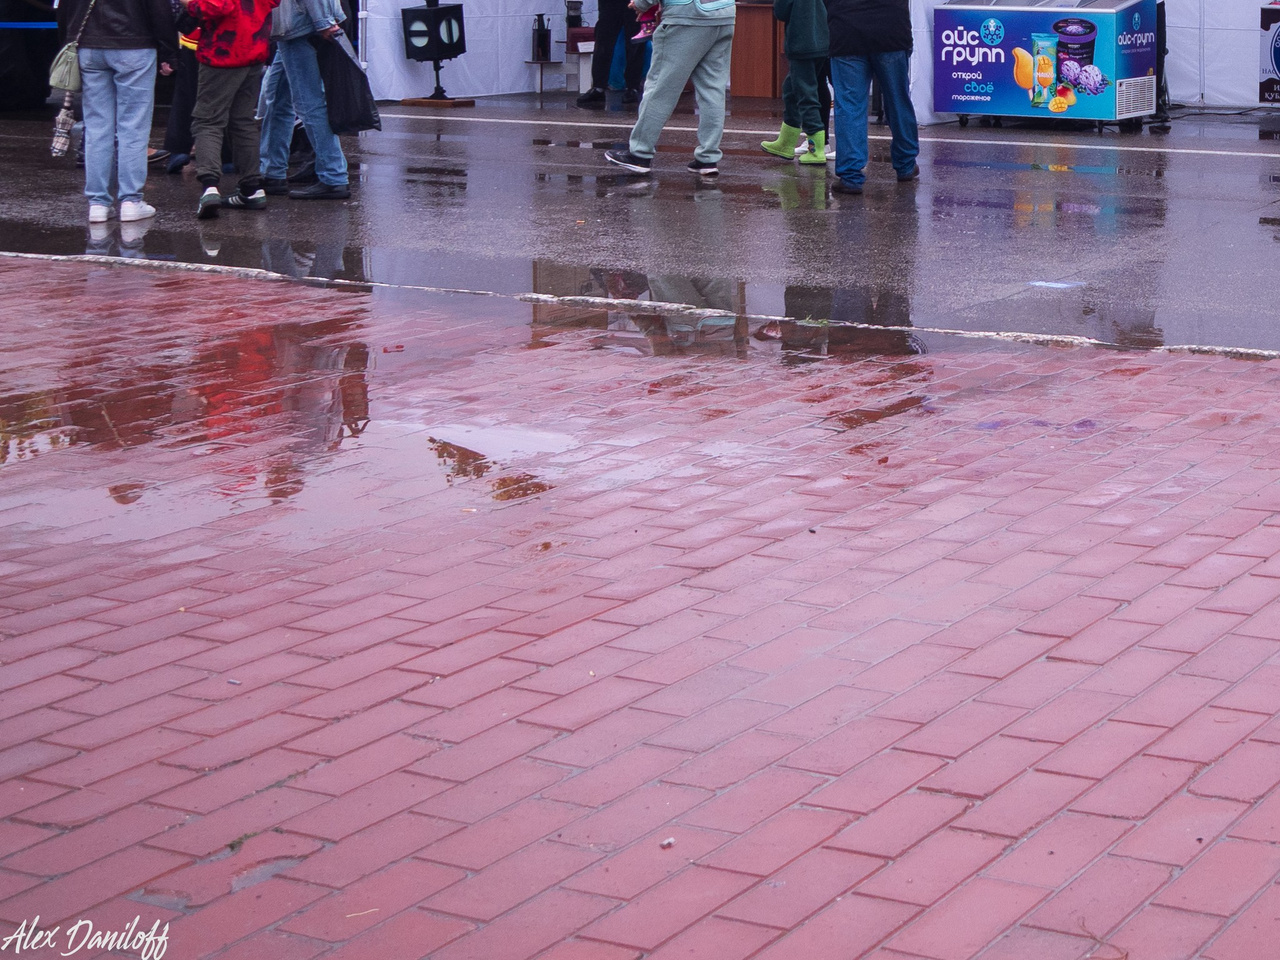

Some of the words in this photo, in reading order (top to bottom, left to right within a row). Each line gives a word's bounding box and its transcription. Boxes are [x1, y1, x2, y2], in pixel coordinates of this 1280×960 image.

[941, 26, 979, 45] айс
[1117, 31, 1155, 47] айс-групп
[941, 46, 1005, 66] групп
[952, 71, 982, 80] открой
[964, 81, 994, 93] своё
[952, 94, 991, 102] мороженое
